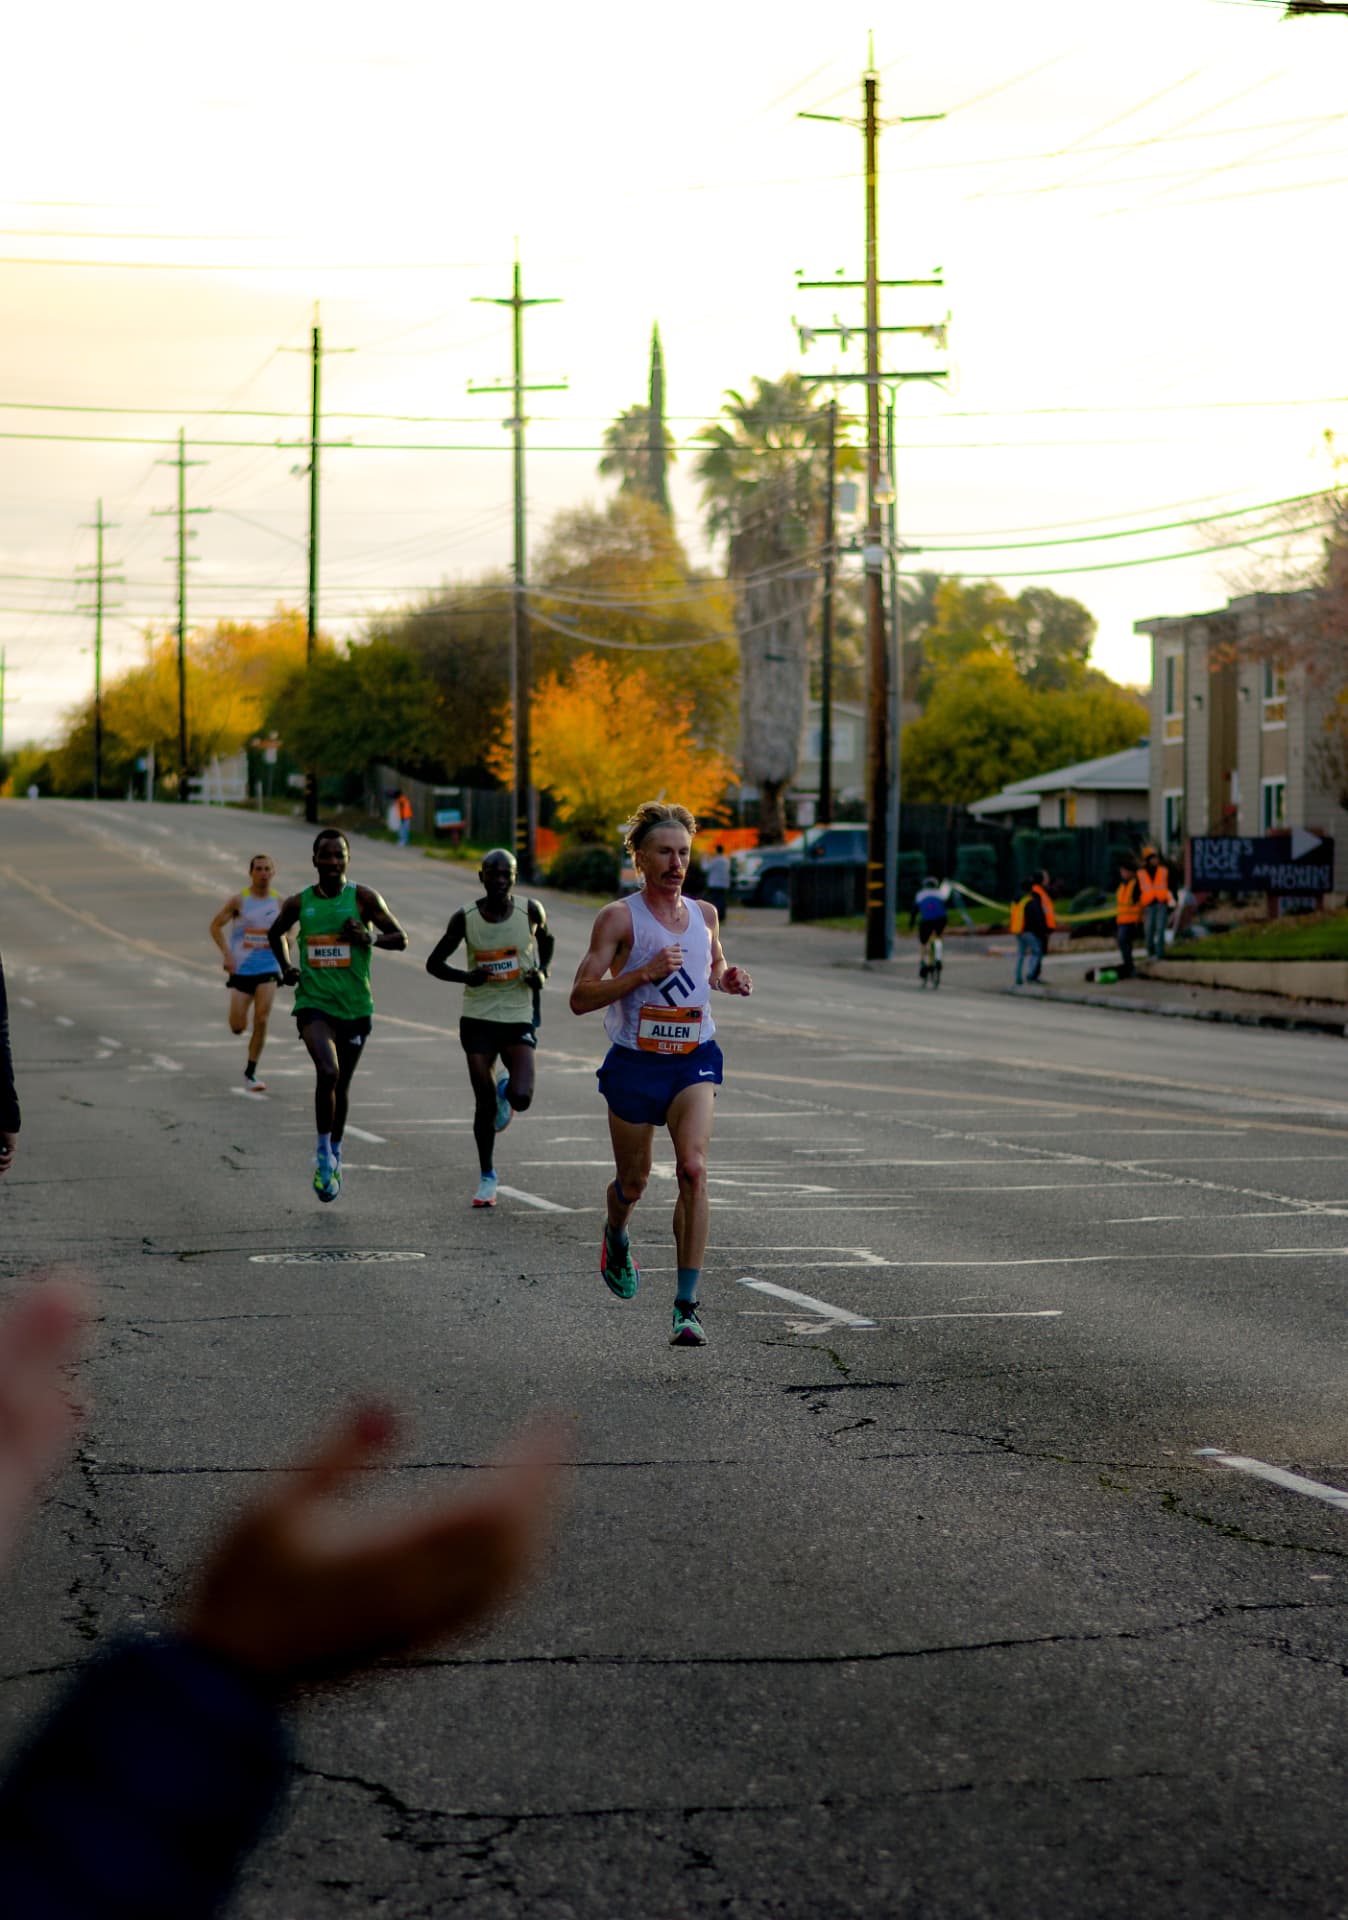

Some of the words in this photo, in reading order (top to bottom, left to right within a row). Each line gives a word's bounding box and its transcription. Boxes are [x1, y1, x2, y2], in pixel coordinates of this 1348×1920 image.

[1194, 840, 1253, 855] RIVER'S
[1194, 856, 1238, 870] EDGE
[1253, 865, 1330, 876] APARTMENT
[1271, 876, 1329, 888] HOMES
[651, 1025, 690, 1038] ALLEN
[658, 1042, 684, 1051] ELITE
